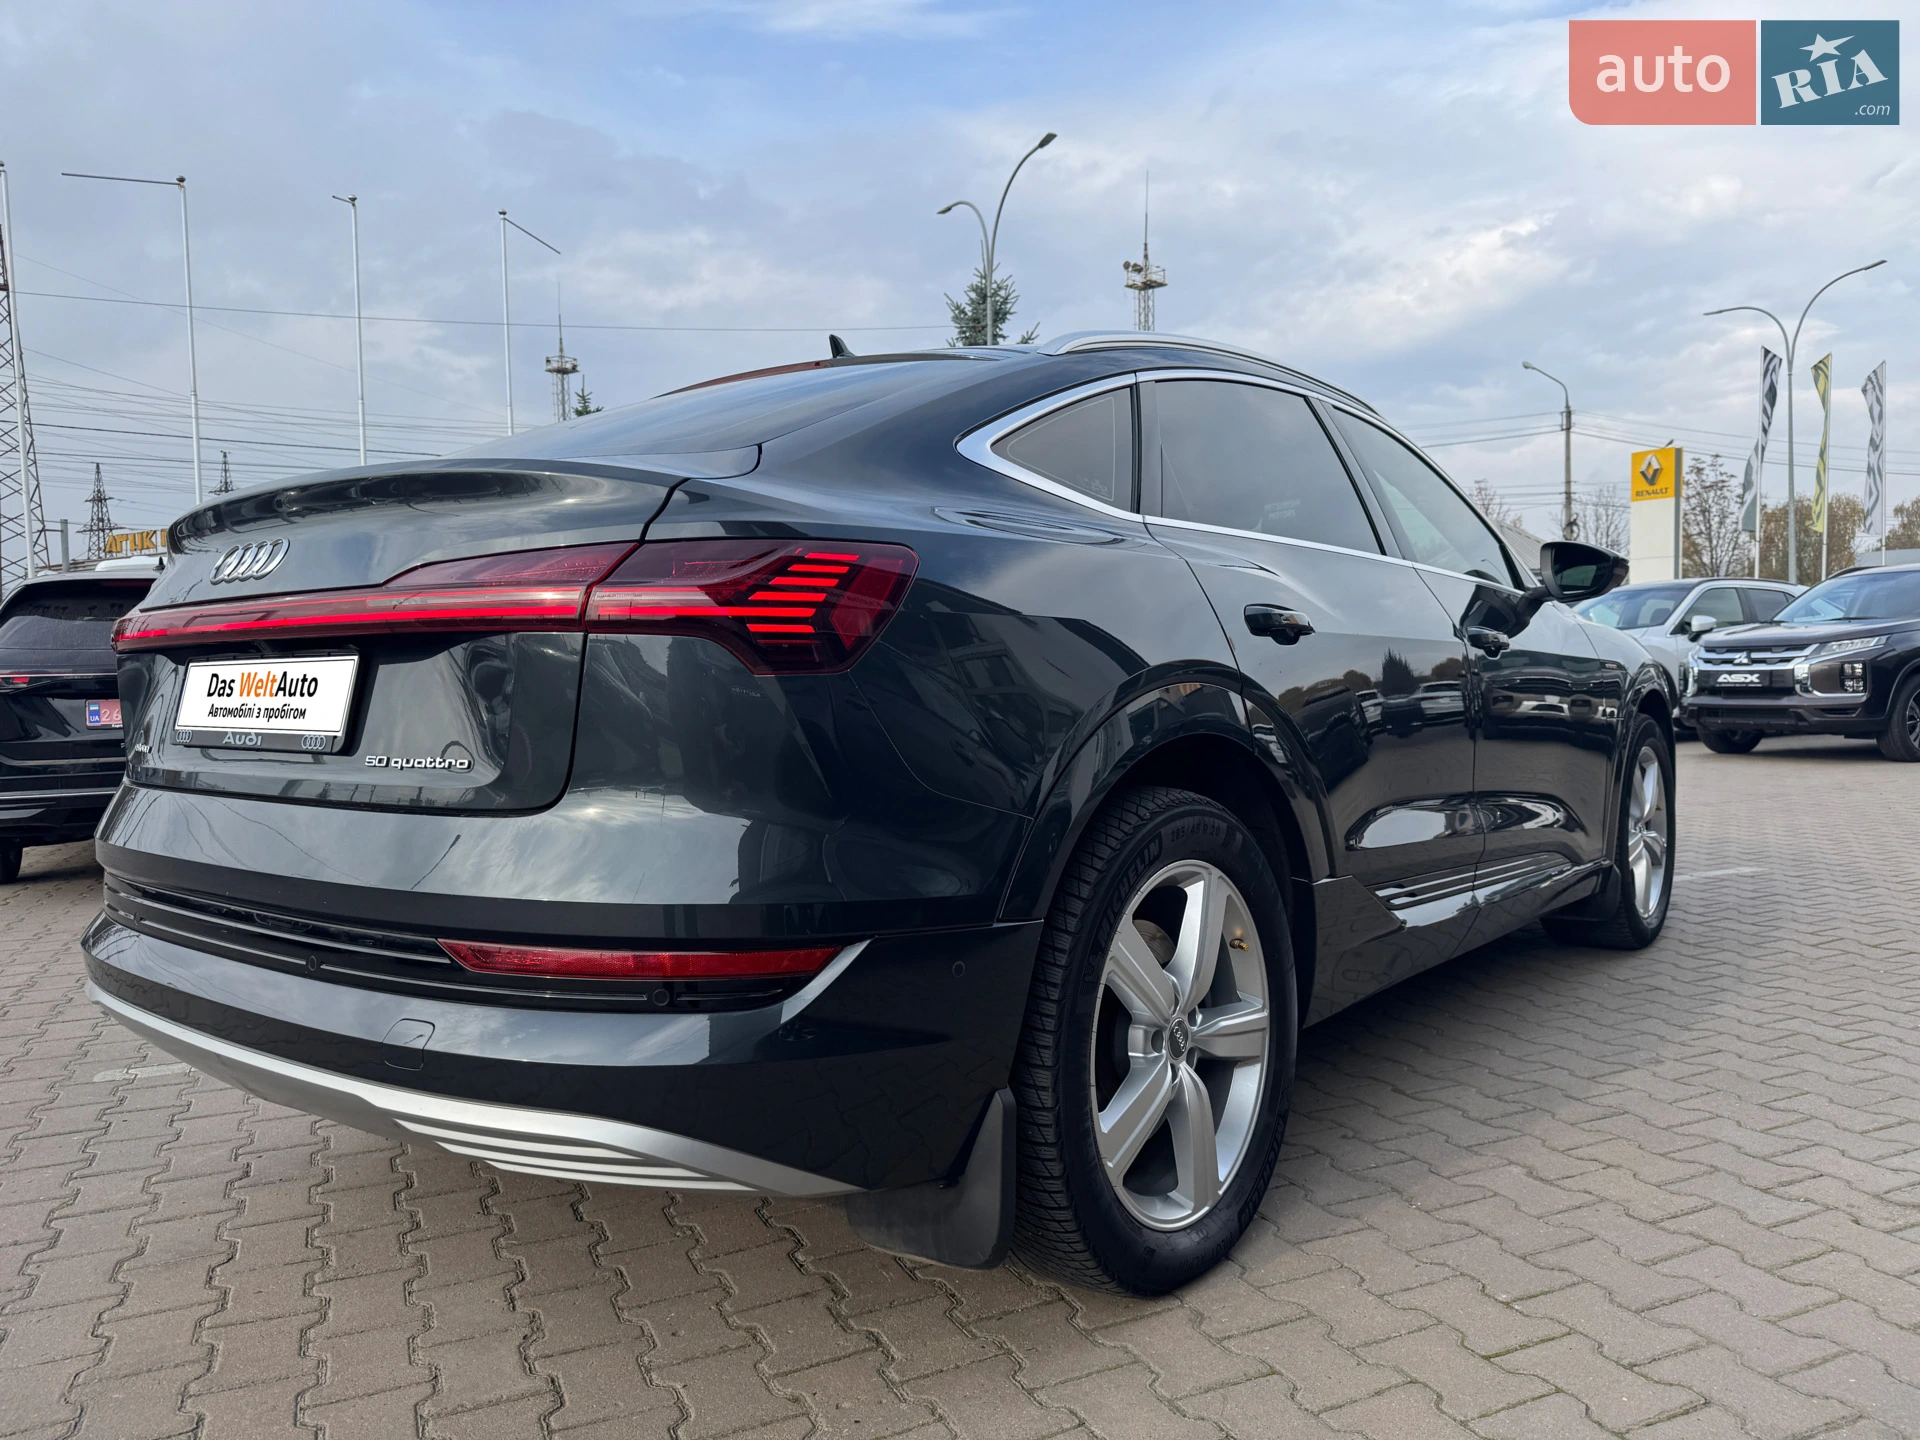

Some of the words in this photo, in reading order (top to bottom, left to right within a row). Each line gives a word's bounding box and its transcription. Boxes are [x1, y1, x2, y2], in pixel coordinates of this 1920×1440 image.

[1635, 488, 1669, 497] RENAULT
[207, 673, 235, 697] Das
[239, 671, 318, 697] WeltAuto
[1717, 673, 1760, 683] ASX
[207, 703, 256, 719] Автомобілі
[256, 709, 261, 719] з
[263, 703, 306, 722] пробігом
[365, 756, 388, 767] 50
[391, 757, 470, 770] quattro
[1203, 823, 1208, 835] R
[1098, 836, 1160, 950] MICHELIN
